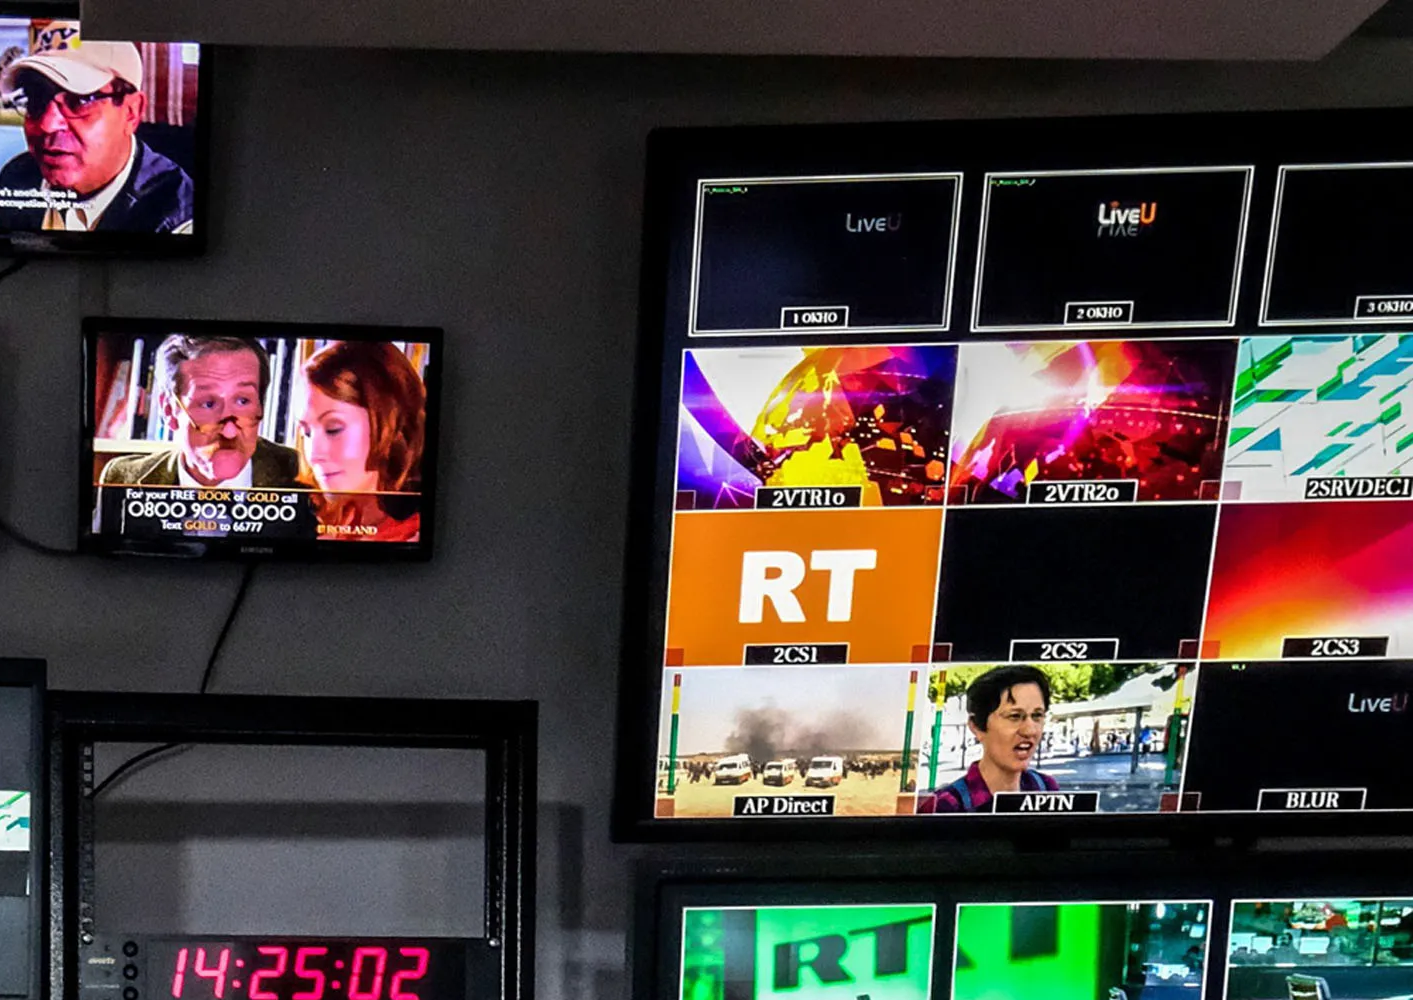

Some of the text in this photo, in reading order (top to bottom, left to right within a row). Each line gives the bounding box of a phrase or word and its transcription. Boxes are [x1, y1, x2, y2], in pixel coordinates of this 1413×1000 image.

[1098, 201, 1156, 225] LiveU
[845, 212, 902, 233] LiveU
[1076, 308, 1085, 319] 2
[1367, 302, 1376, 314] 3
[126, 488, 299, 504] For your FREE BOOK of GOLD call
[772, 488, 845, 507] 2VTR1o
[1045, 484, 1120, 502] 2VTR2o
[1307, 479, 1410, 498] 2SRVDEC1
[128, 501, 296, 521] 0800 902 0000
[161, 519, 263, 533] Text GOLD to 66777
[326, 525, 378, 536] ROSLAND
[739, 549, 877, 624] RT
[773, 646, 818, 664] 2CS1
[1041, 642, 1089, 660] 2CS2
[1311, 639, 1360, 656] 2CS3
[1349, 692, 1409, 713] LiveU
[741, 796, 829, 815] AP Direct
[1020, 794, 1075, 812] APTN
[1285, 791, 1340, 809] BLUR
[773, 914, 934, 992] RT
